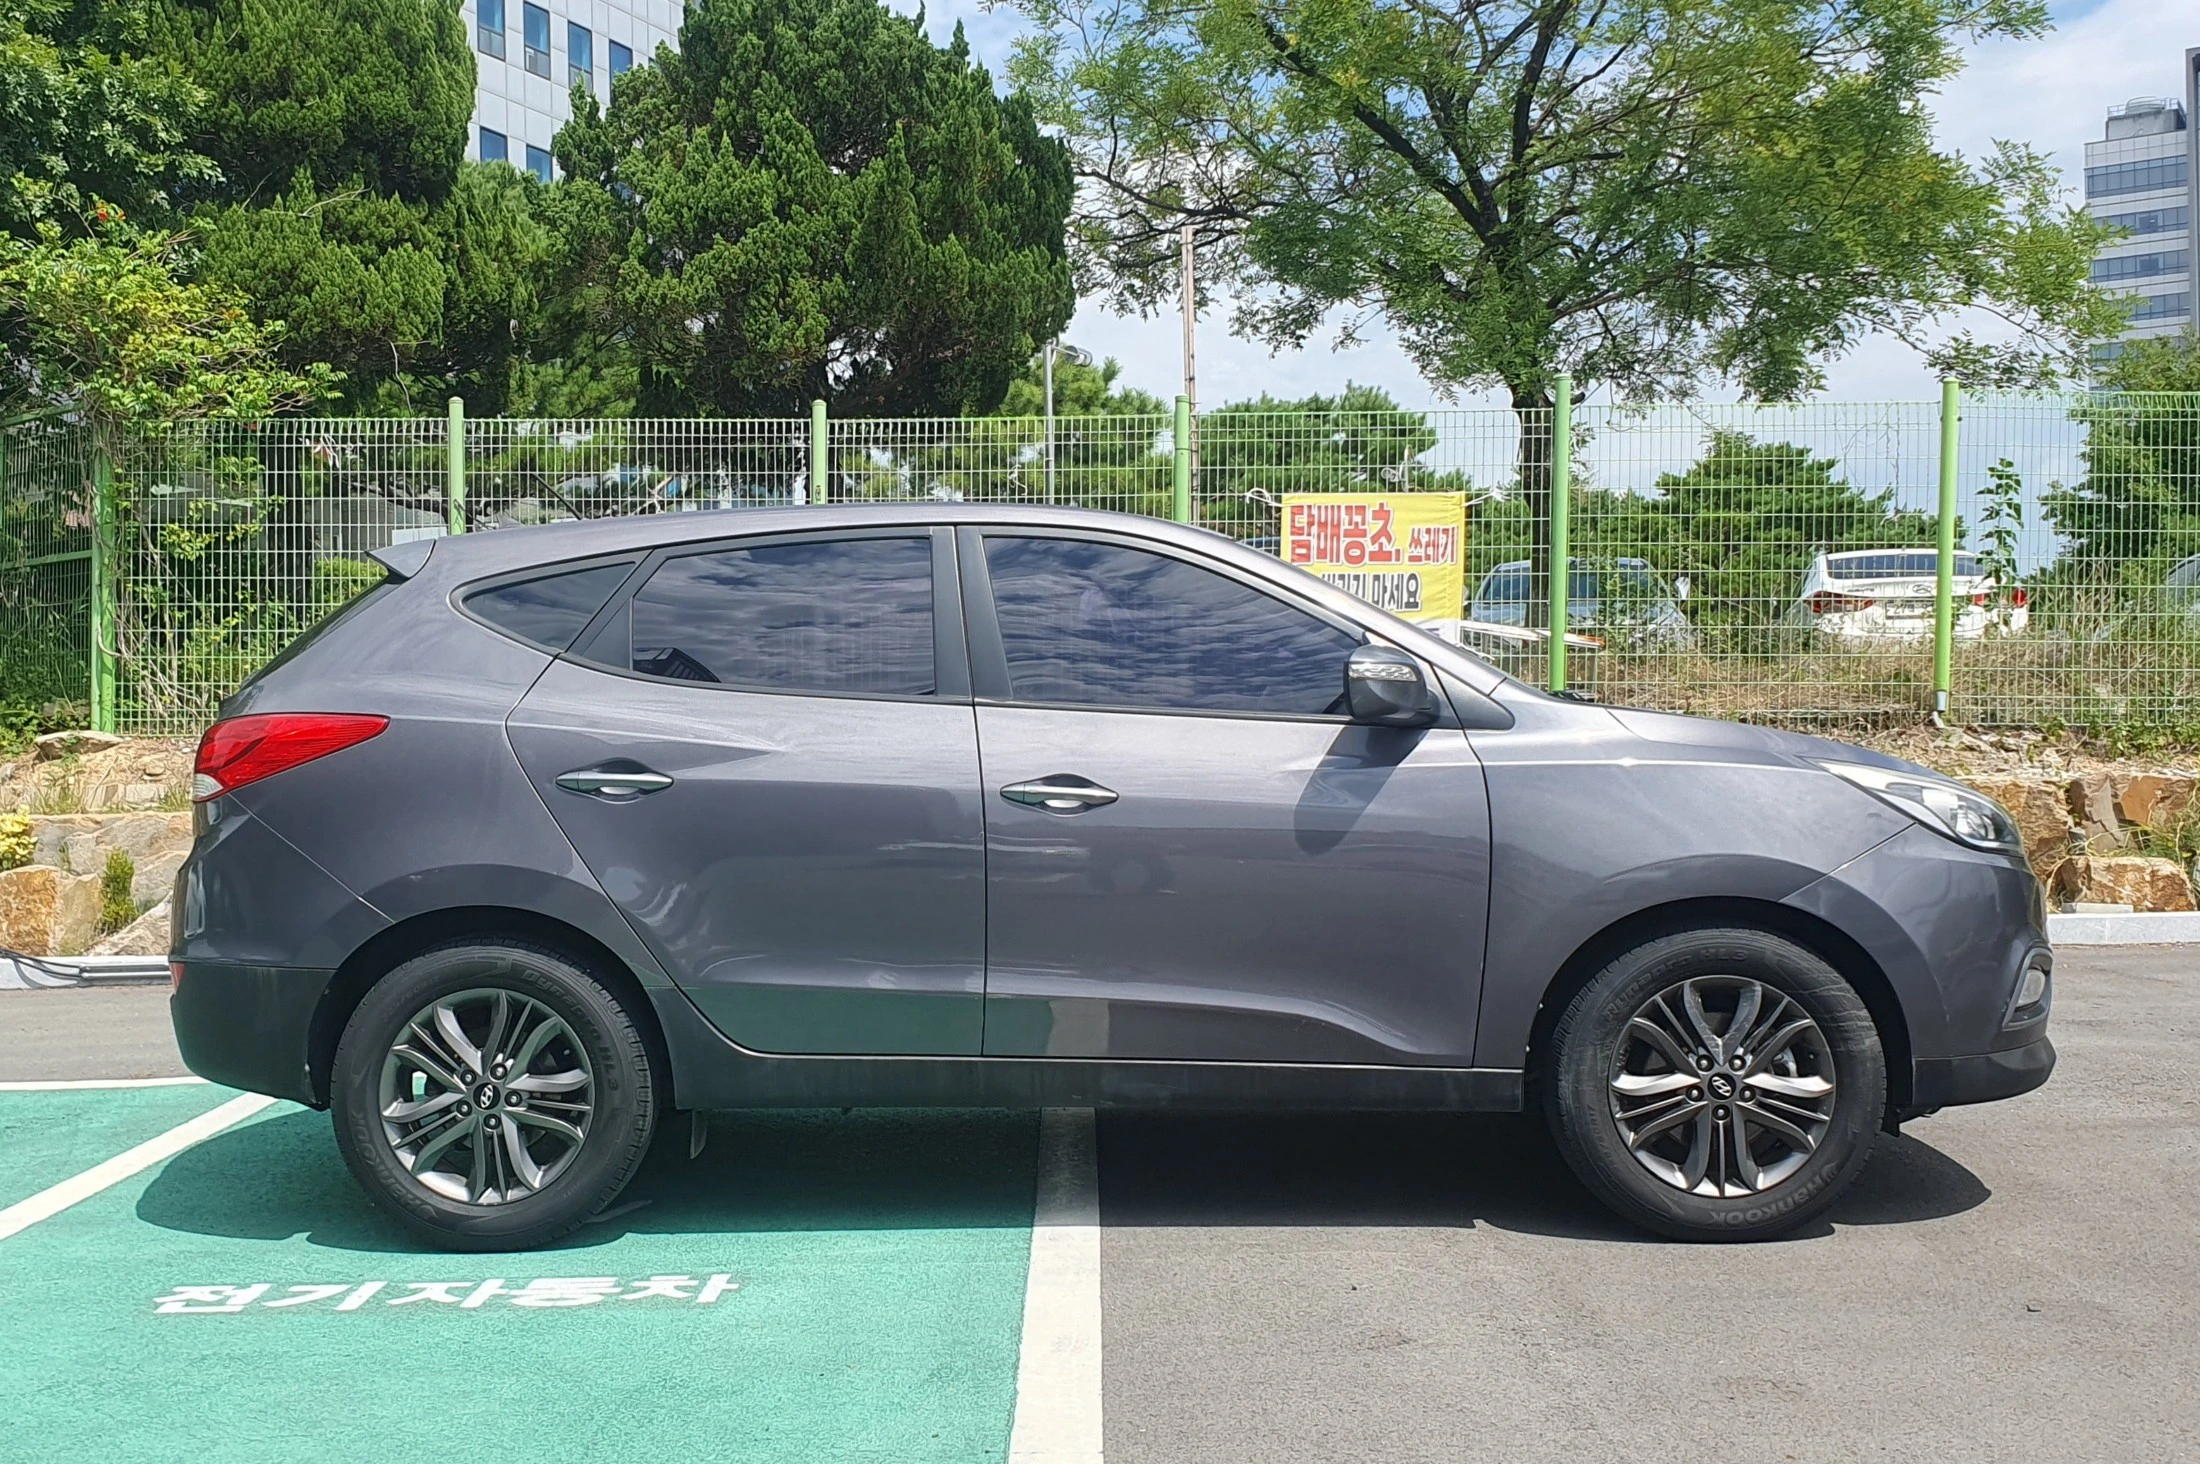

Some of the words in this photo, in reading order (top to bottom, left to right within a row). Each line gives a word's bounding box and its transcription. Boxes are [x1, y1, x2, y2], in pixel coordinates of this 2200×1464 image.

[1407, 527, 1457, 563] 쓰레기
[1371, 572, 1420, 610] 마세요
[153, 1273, 740, 1314] 전기자동차
